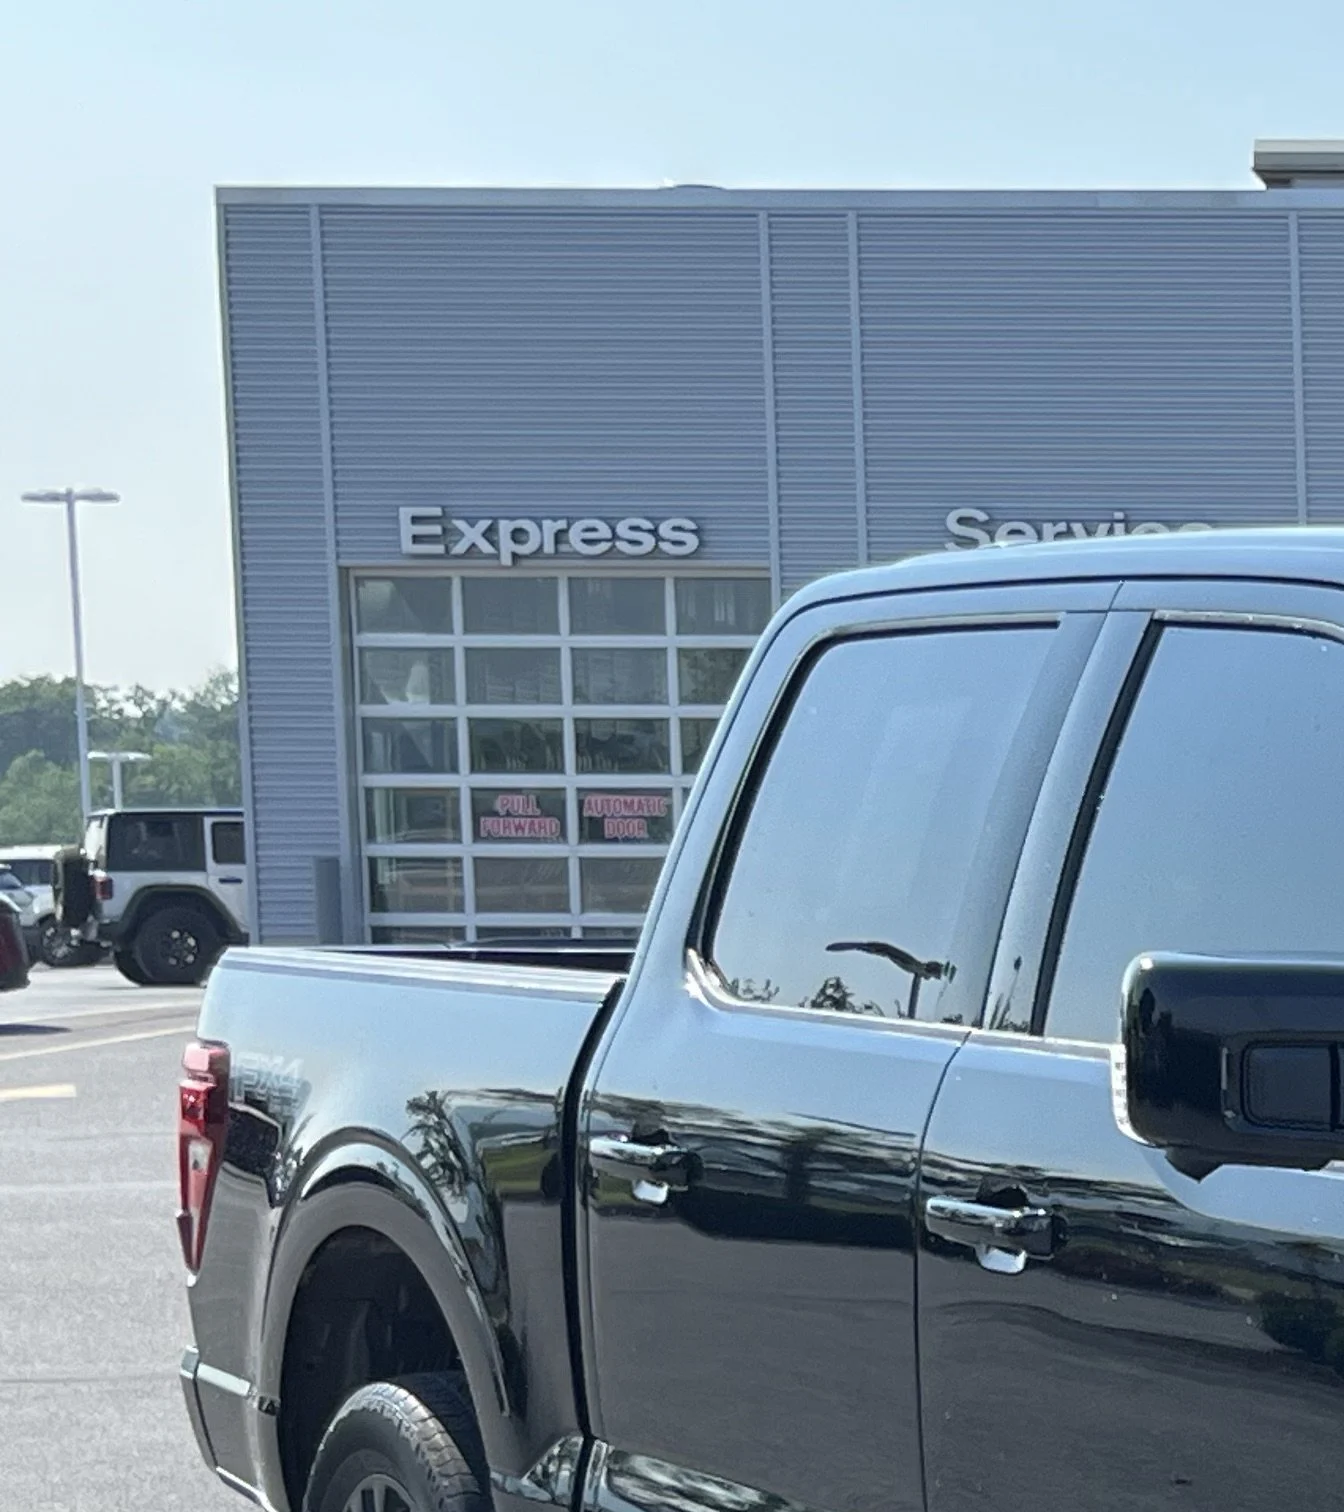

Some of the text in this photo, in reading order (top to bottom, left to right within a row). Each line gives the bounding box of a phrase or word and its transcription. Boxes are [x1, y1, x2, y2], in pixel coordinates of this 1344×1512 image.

[398, 506, 699, 566] Express
[945, 507, 1214, 550] Servi
[495, 795, 541, 815] PULL
[583, 796, 668, 817] AUTOMATIC
[480, 816, 560, 838] FORWARD
[604, 817, 648, 838] DOOR
